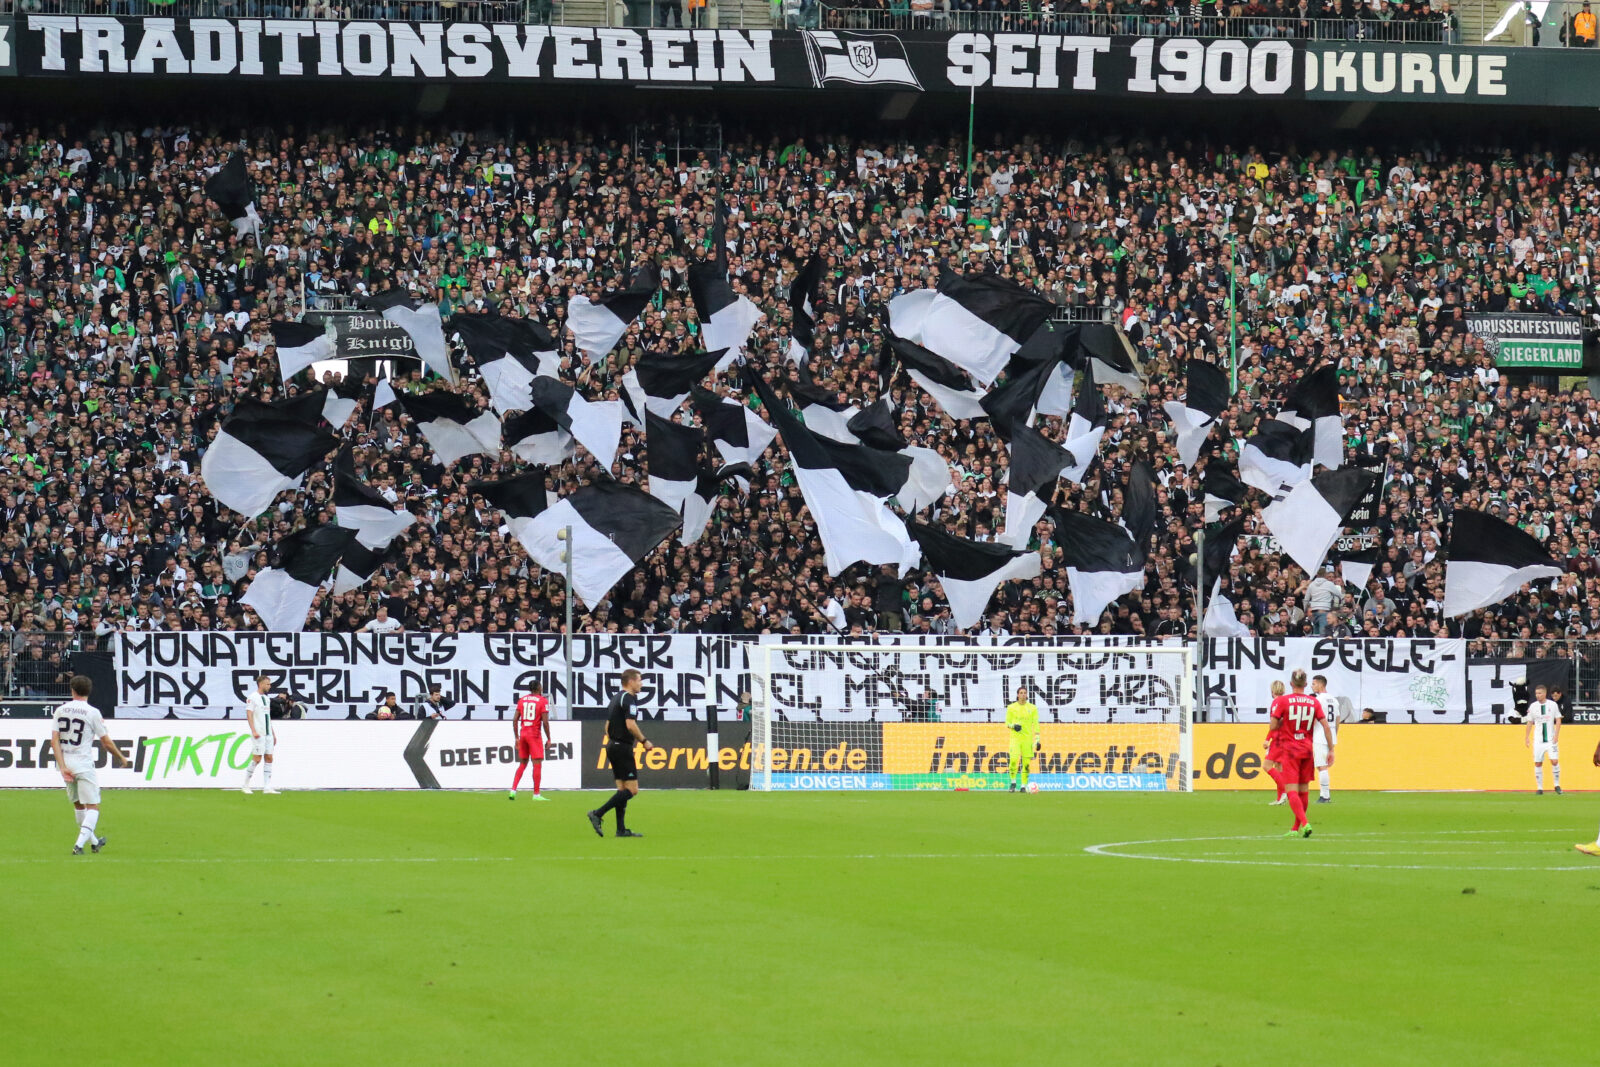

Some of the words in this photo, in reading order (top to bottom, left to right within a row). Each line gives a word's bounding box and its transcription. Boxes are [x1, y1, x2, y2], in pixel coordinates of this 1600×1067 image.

[28, 15, 776, 82] TRADITIONSVEREIN
[946, 32, 1111, 90] SEIT
[1127, 38, 1294, 95] 1900
[348, 315, 401, 332] Borus
[1466, 319, 1580, 335] BORUSSENFESTUNG
[346, 336, 413, 351] Knigh
[1503, 347, 1581, 363] SIEGERLAND
[122, 632, 459, 667] MONATELANGES
[484, 633, 674, 669] GEPOKER
[695, 633, 760, 669] MIT
[781, 634, 901, 671] EINEM
[919, 635, 1164, 671] KONSTRUKT
[1182, 636, 1285, 671] OHNE
[122, 670, 209, 706] MAX
[400, 669, 489, 704] DEIN
[1002, 673, 1078, 708] UNS
[523, 701, 537, 721] 18
[1288, 704, 1315, 732] 44
[57, 716, 85, 747] 23
[440, 747, 482, 767] DIE
[485, 742, 574, 765] FOEN
[597, 735, 868, 771] iterwetten.de
[929, 736, 1262, 780] intewetten.de
[790, 775, 867, 789] JONGEN
[1066, 775, 1141, 789] JONGEN
